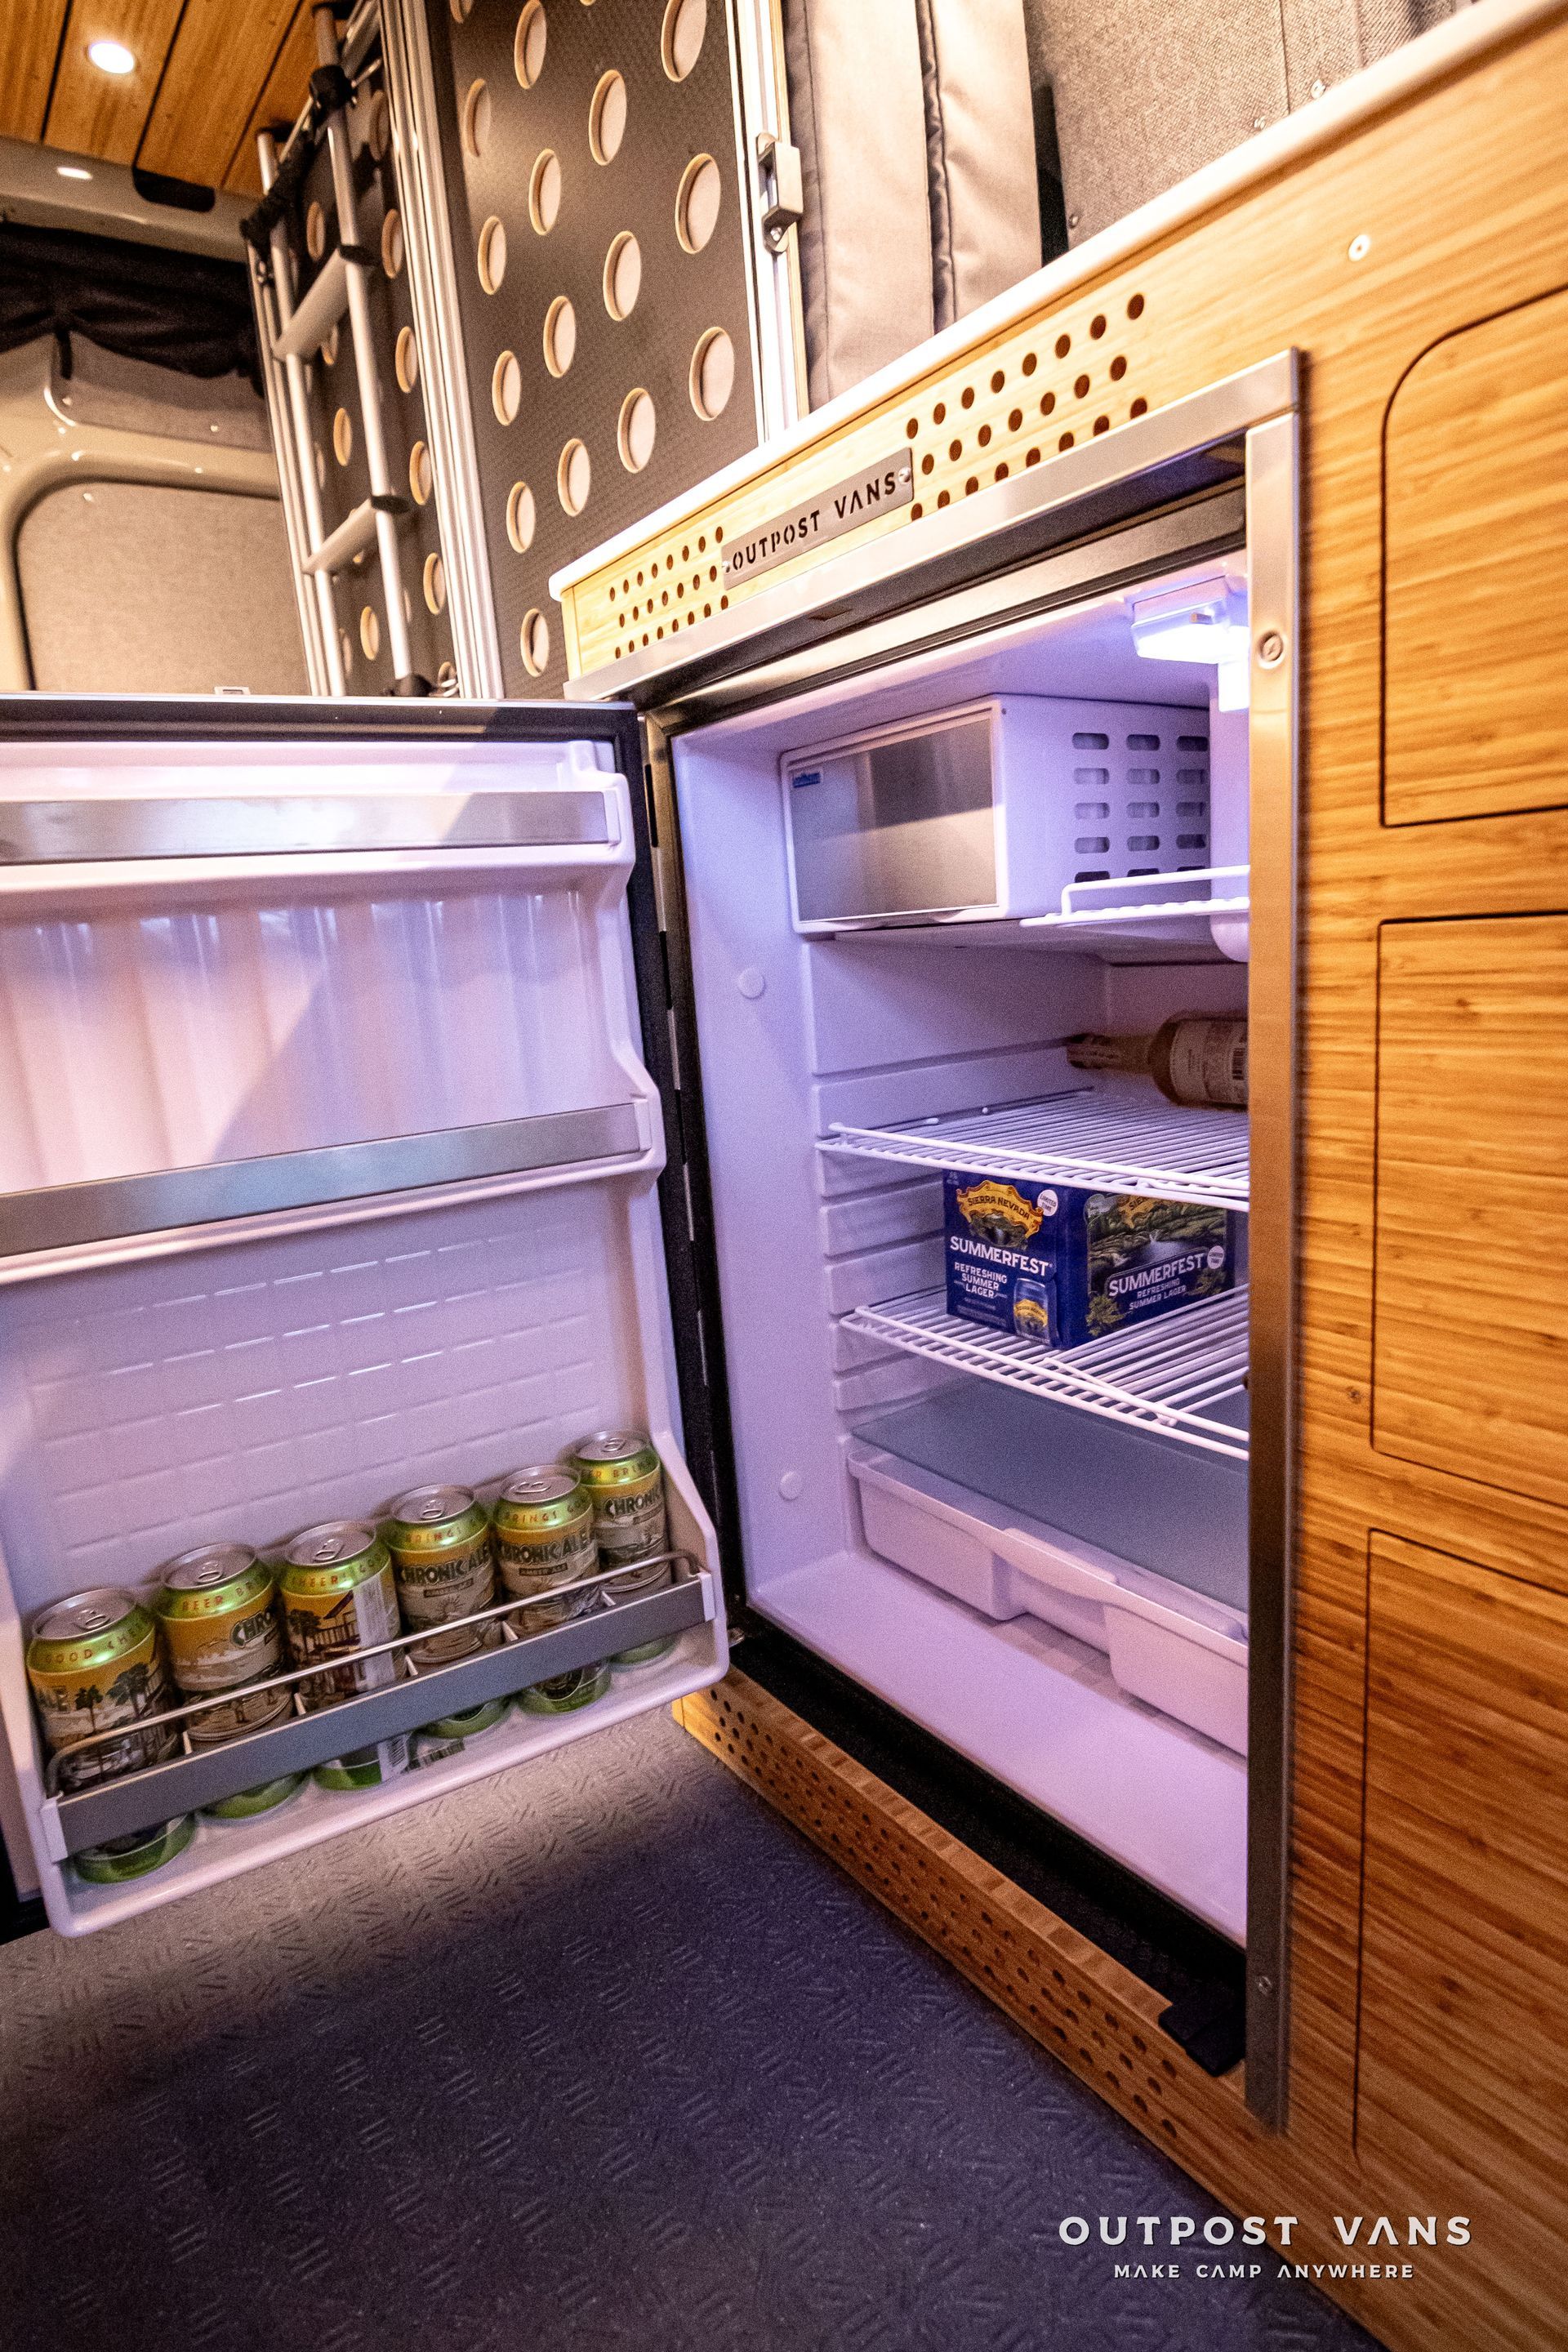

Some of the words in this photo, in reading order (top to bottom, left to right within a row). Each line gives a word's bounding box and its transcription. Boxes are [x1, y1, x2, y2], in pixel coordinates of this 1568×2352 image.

[733, 510, 820, 570] OUTPOST
[834, 472, 896, 519] VANS
[968, 1196, 996, 1206] SIERRA
[998, 1197, 1030, 1220] NEVADA
[950, 1236, 1049, 1276] SUMMERFEST
[955, 1262, 1007, 1284] REFRESHING
[962, 1273, 999, 1290] SUMMER
[1109, 1253, 1205, 1297] SUMMERFEST
[965, 1283, 995, 1298] LAGER
[1129, 1295, 1161, 1310] SUMMER
[1164, 1285, 1187, 1298] LAGER
[1137, 1278, 1180, 1298] REFRESHING
